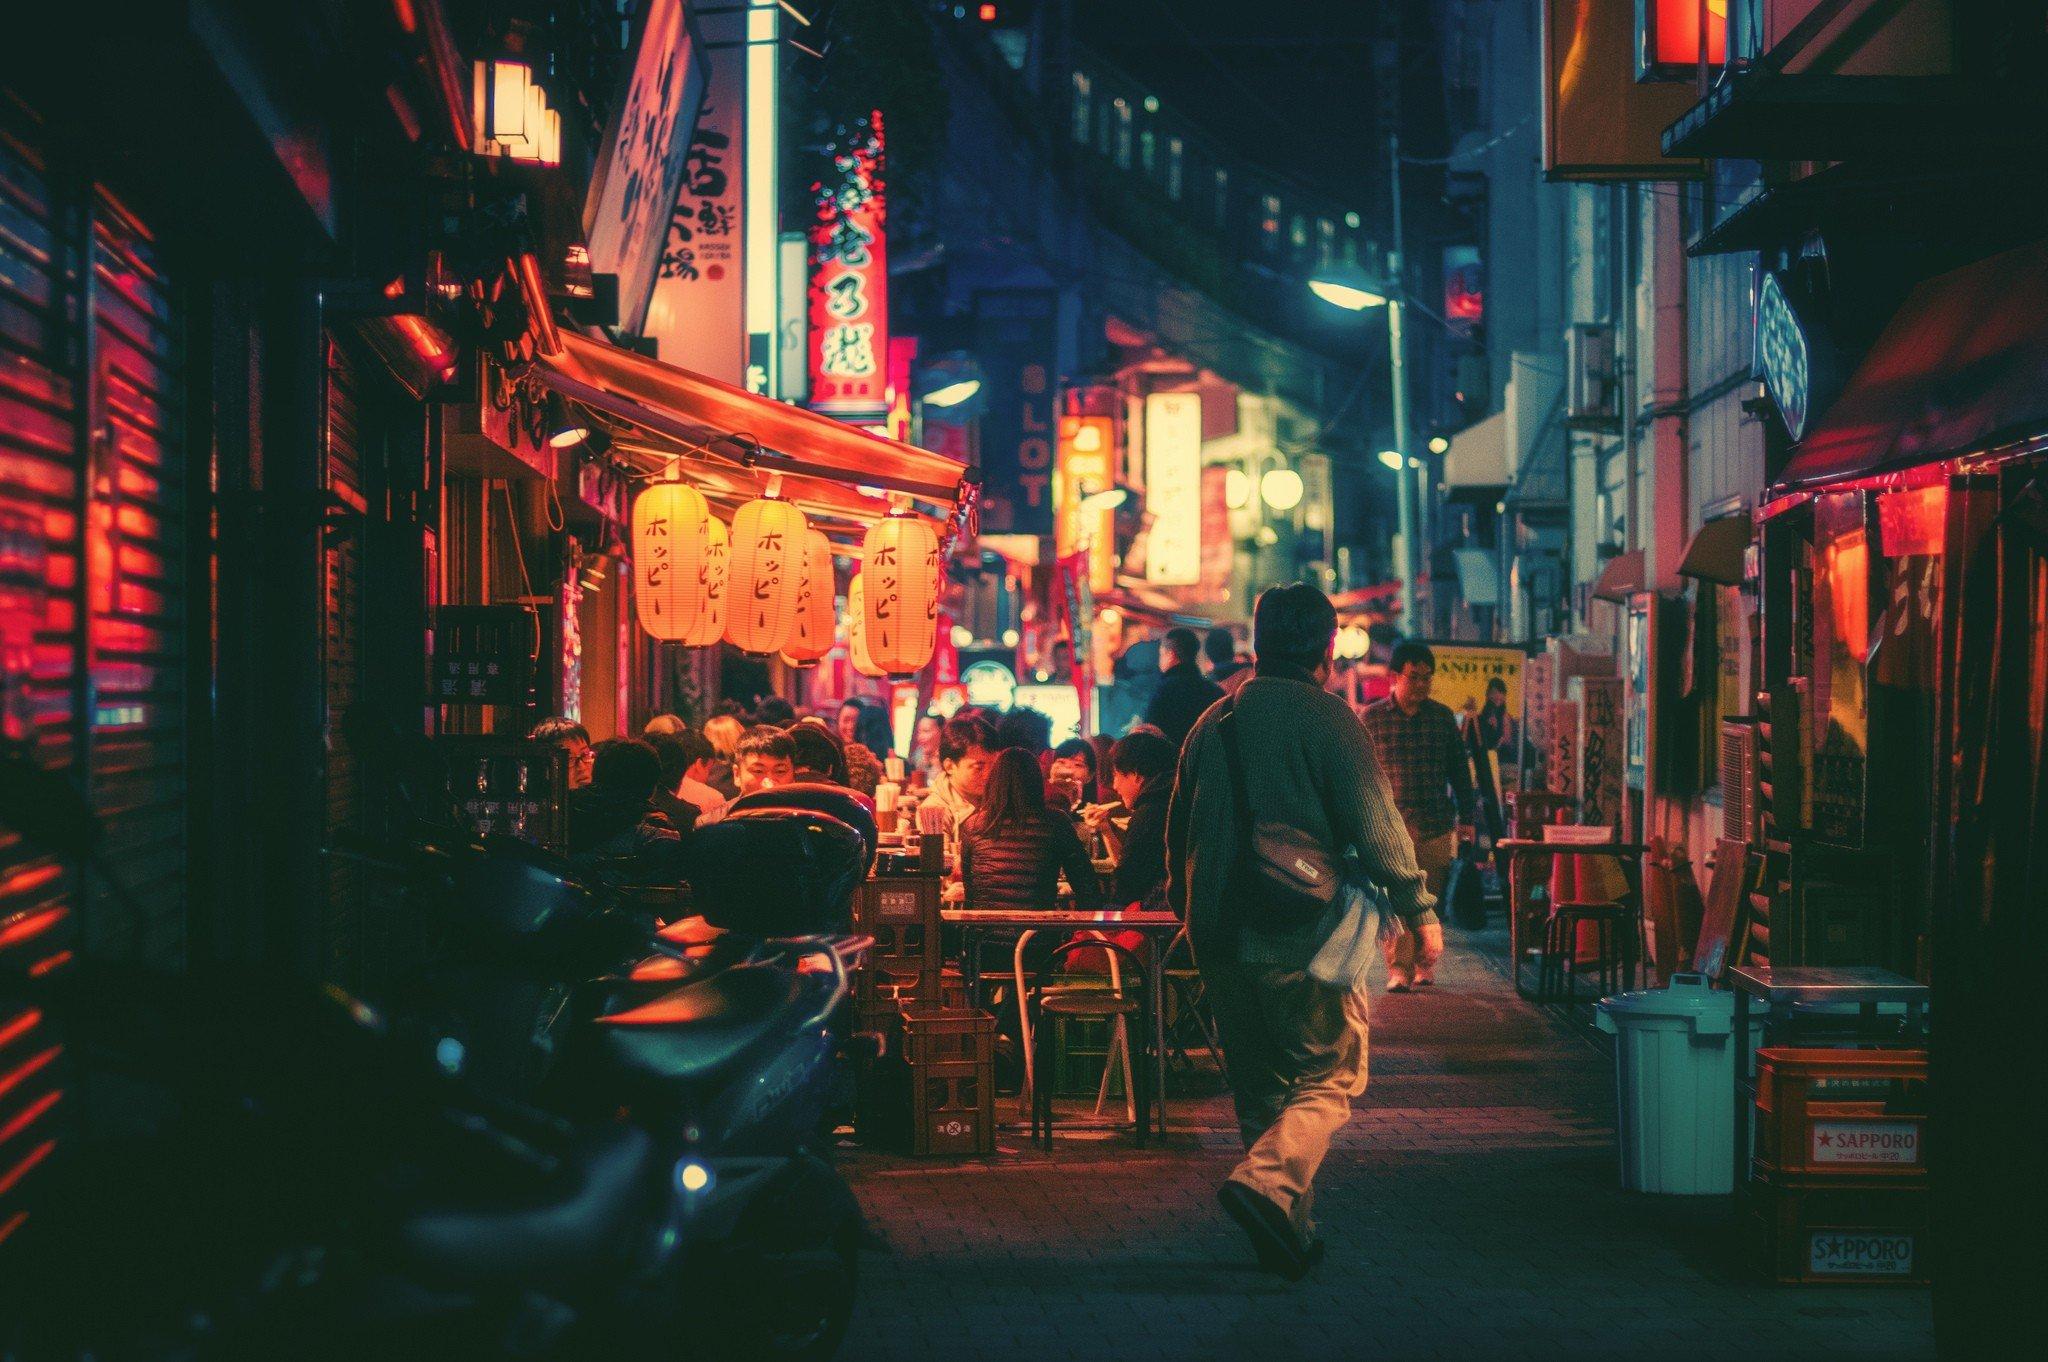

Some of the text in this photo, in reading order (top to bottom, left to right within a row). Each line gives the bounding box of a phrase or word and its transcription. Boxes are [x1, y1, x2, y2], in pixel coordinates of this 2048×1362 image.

[646, 514, 669, 616] ホッピー
[754, 527, 783, 629] ホッピー
[873, 541, 898, 649] ホッピー
[1837, 1133, 1915, 1149] SAPPORO
